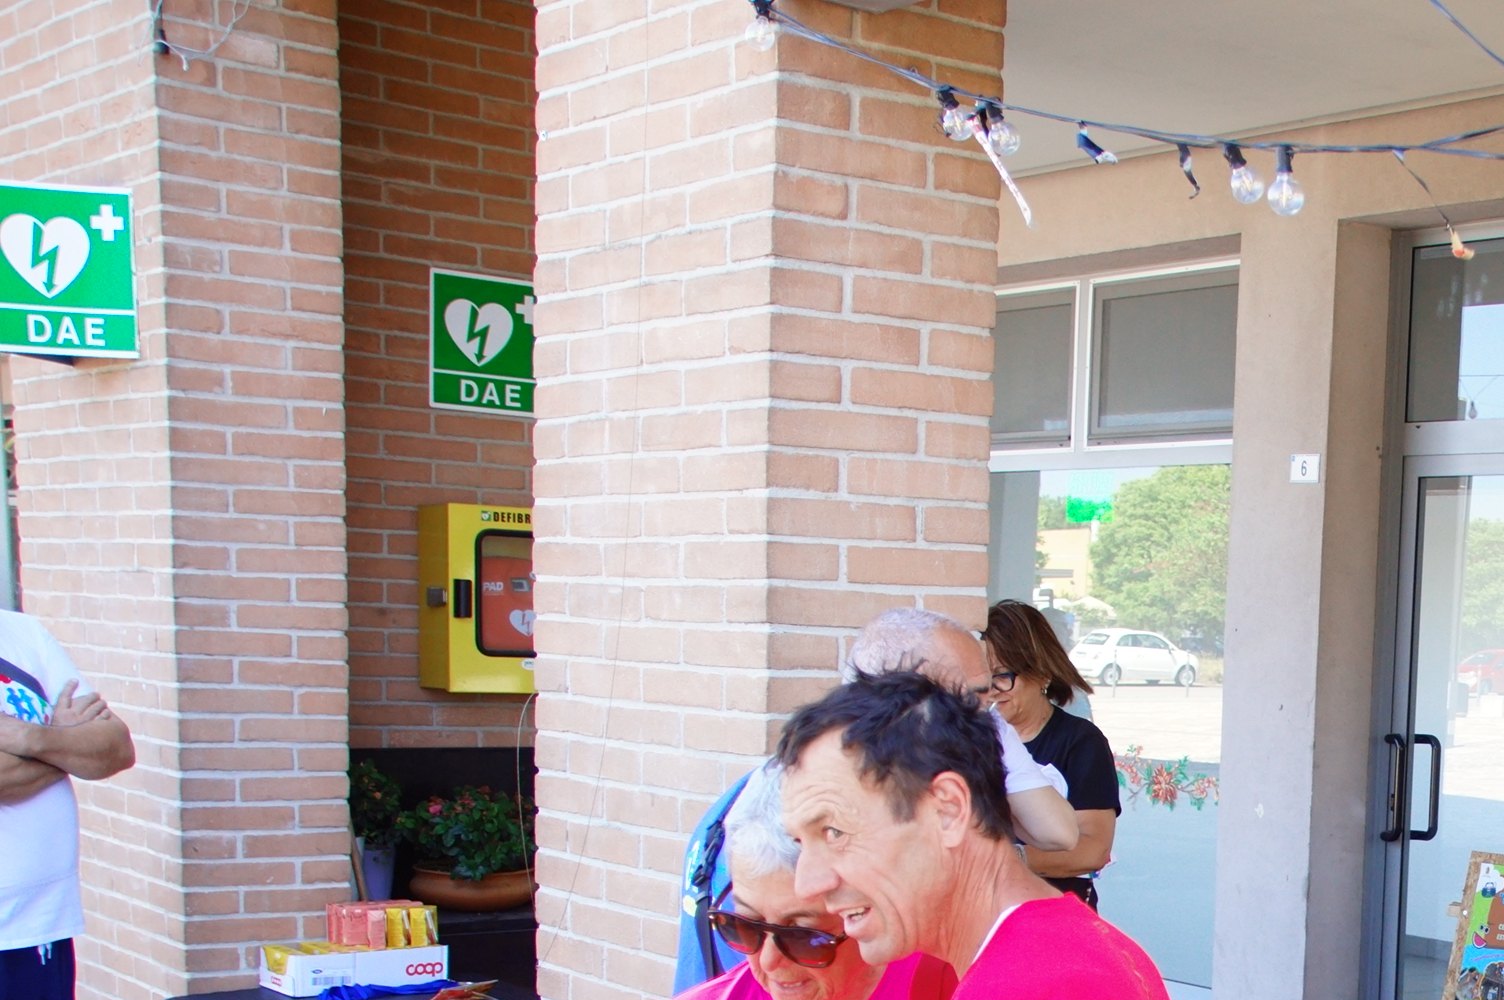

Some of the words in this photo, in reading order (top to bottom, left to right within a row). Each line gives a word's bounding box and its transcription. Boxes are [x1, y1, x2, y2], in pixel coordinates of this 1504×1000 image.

[26, 314, 106, 346] DAE
[460, 379, 522, 408] DAE
[1300, 460, 1308, 477] 6
[405, 961, 443, 977] coop
